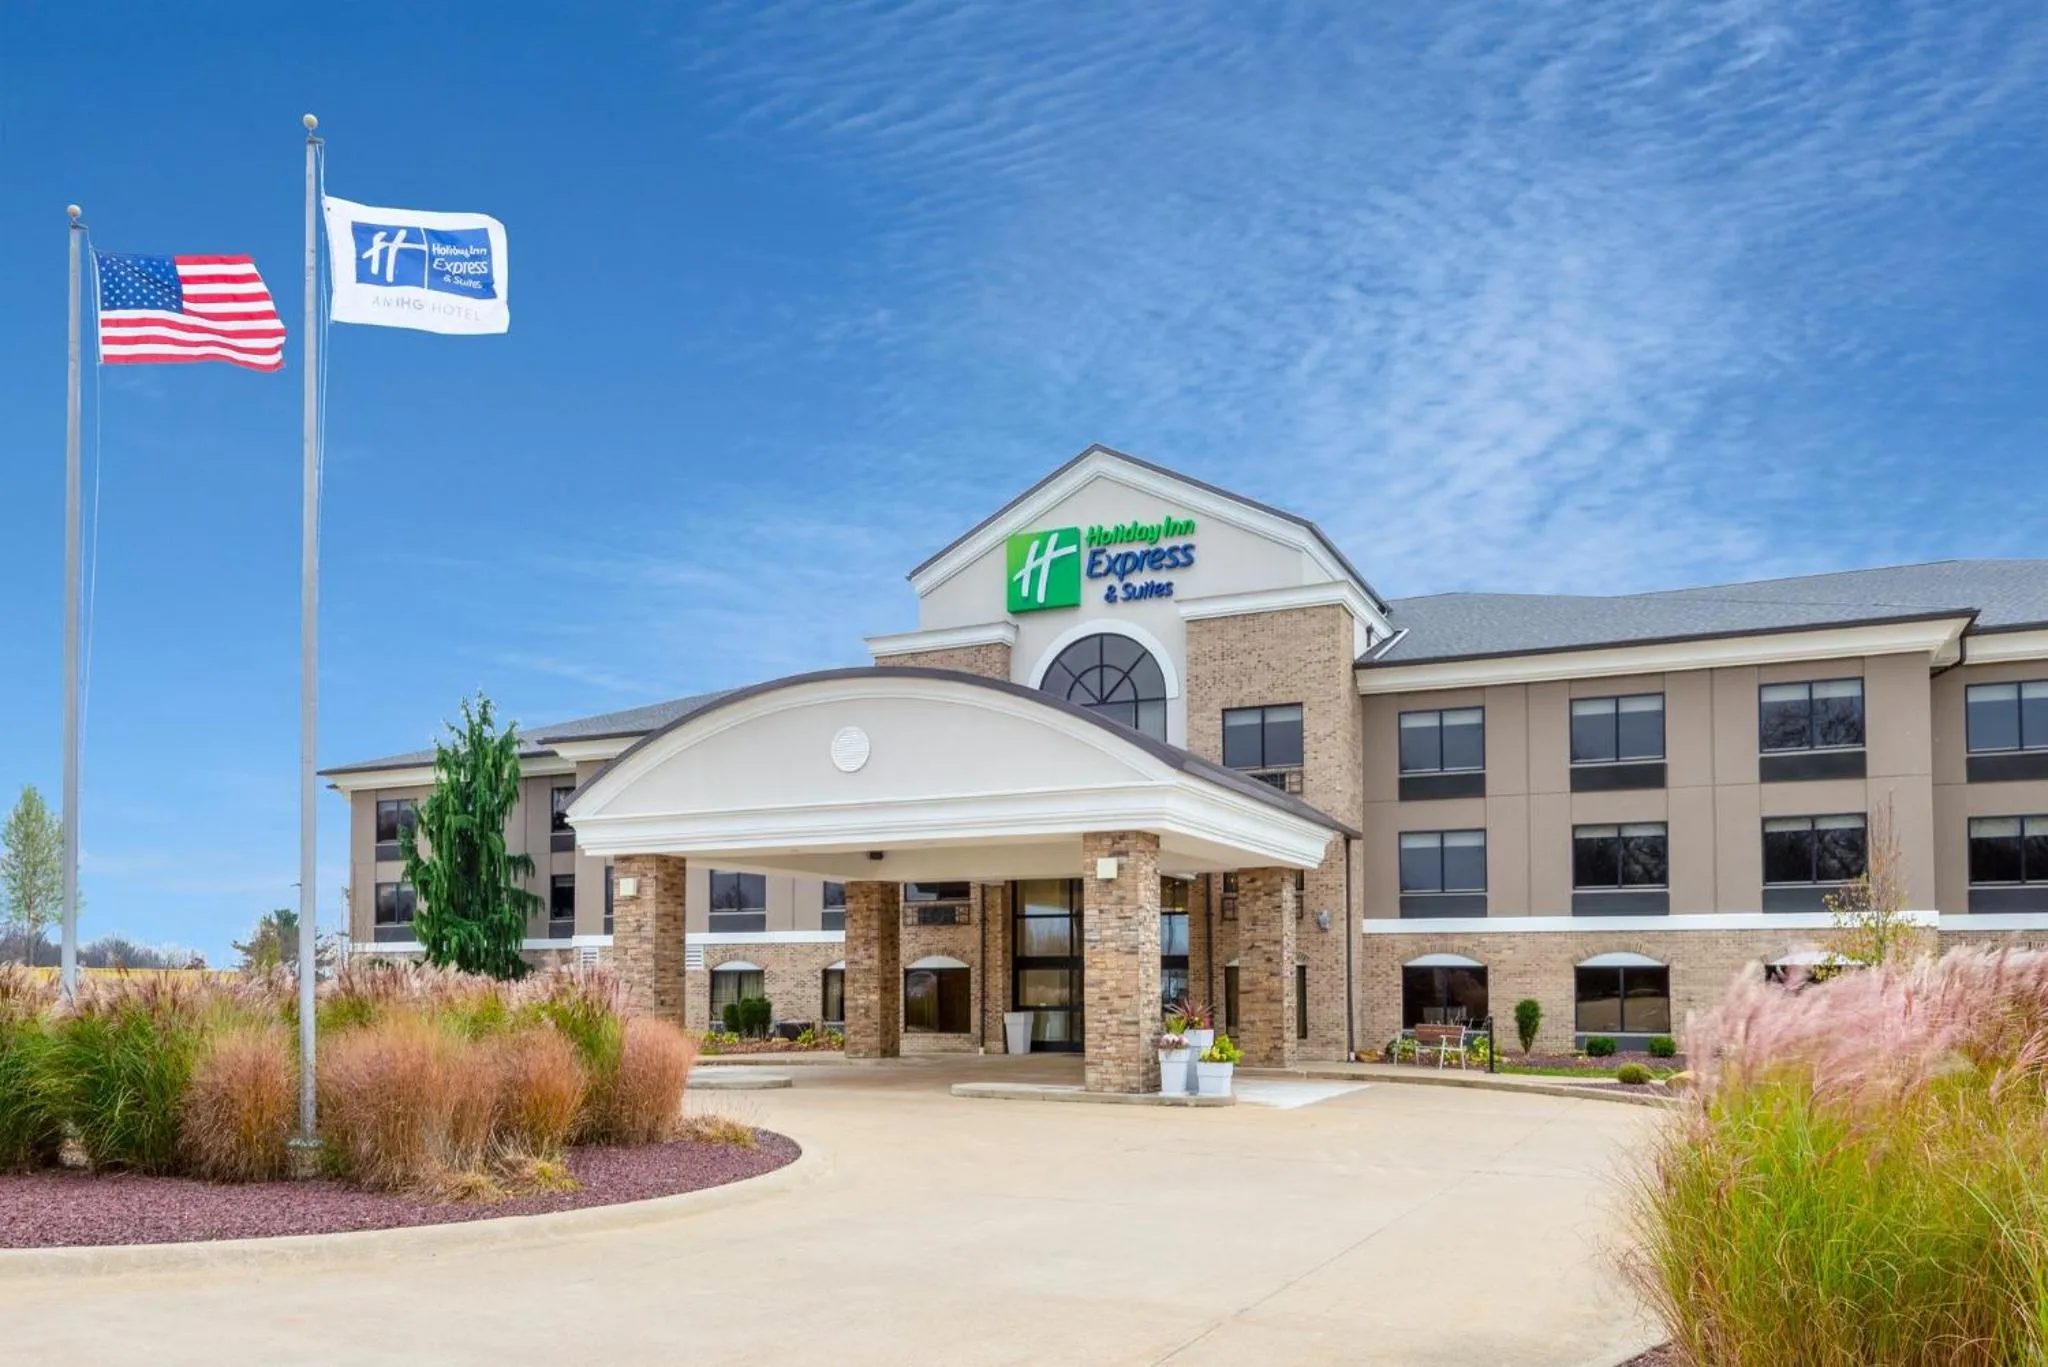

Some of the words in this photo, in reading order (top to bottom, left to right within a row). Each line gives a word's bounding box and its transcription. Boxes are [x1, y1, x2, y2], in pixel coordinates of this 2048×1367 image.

[469, 244, 487, 256] Inn
[432, 257, 488, 275] Express
[443, 274, 451, 283] &
[453, 276, 482, 289] Suites
[395, 296, 424, 310] IHG
[432, 302, 480, 322] HOTEL
[1086, 520, 1161, 547] Holiday
[1163, 515, 1195, 538] Inn
[1086, 543, 1195, 581] Express
[1104, 584, 1118, 603] &
[1121, 580, 1174, 602] Suites
